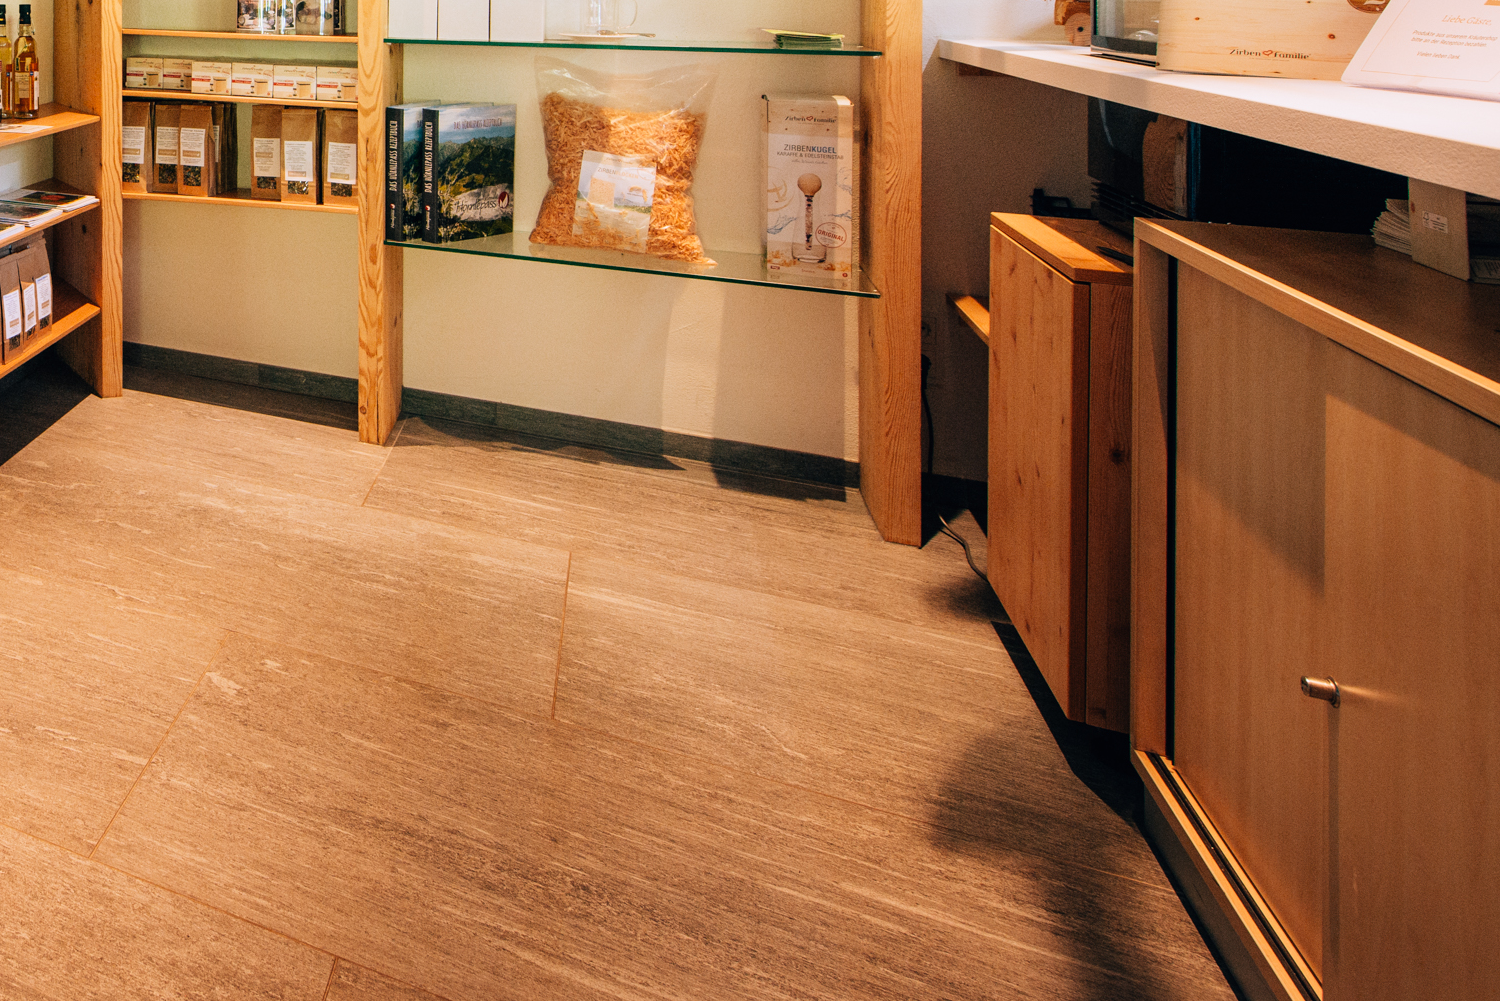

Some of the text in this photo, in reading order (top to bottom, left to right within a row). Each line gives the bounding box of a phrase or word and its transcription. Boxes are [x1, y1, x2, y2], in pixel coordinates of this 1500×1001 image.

[1441, 14, 1493, 26] Liebe Gäste,
[1412, 29, 1435, 39] Produkte
[1229, 49, 1311, 60] Zirben Familie
[424, 121, 433, 150] REZEPTBUCH
[783, 144, 837, 154] ZIRBENKUGEL
[424, 182, 433, 193] DAS
[456, 199, 497, 213] Hörnlepass
[817, 229, 845, 243] ORIGINAL
